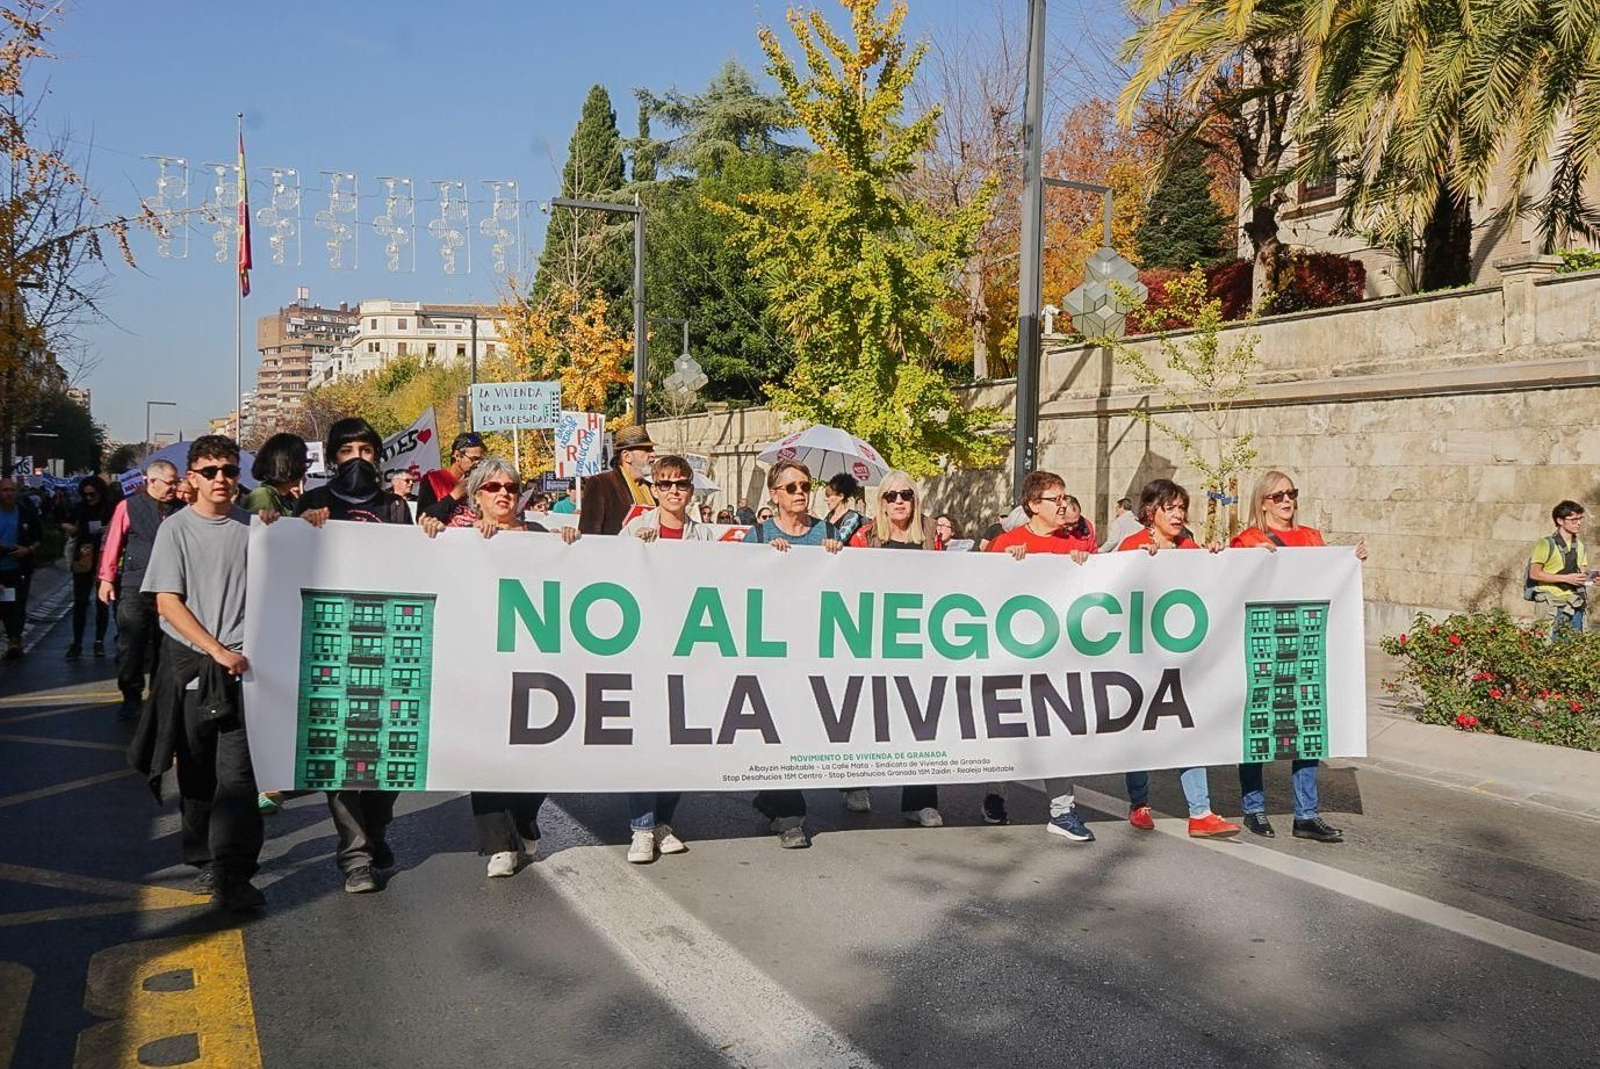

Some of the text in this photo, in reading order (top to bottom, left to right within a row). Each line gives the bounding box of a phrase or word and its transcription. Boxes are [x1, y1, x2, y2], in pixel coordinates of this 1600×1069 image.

[479, 387, 543, 398] LA VIVIENDA
[483, 414, 549, 426] ES NECESIDAD
[496, 578, 1209, 660] NO AL NEGOCIO
[509, 668, 1195, 745] DE LA VIVIENDA
[790, 754, 841, 762] MOVIMIENTO
[856, 752, 893, 761] VIVIENDA
[894, 752, 905, 760] DE
[907, 750, 947, 759] GRANADA
[781, 763, 815, 771] Habitable
[960, 758, 991, 766] Granada
[722, 774, 740, 782] Stop
[741, 773, 782, 781] Desahucios
[798, 772, 823, 780] Centro
[828, 771, 845, 779] Stop
[846, 769, 886, 778] Desahucios
[983, 765, 1015, 773] Habitable
